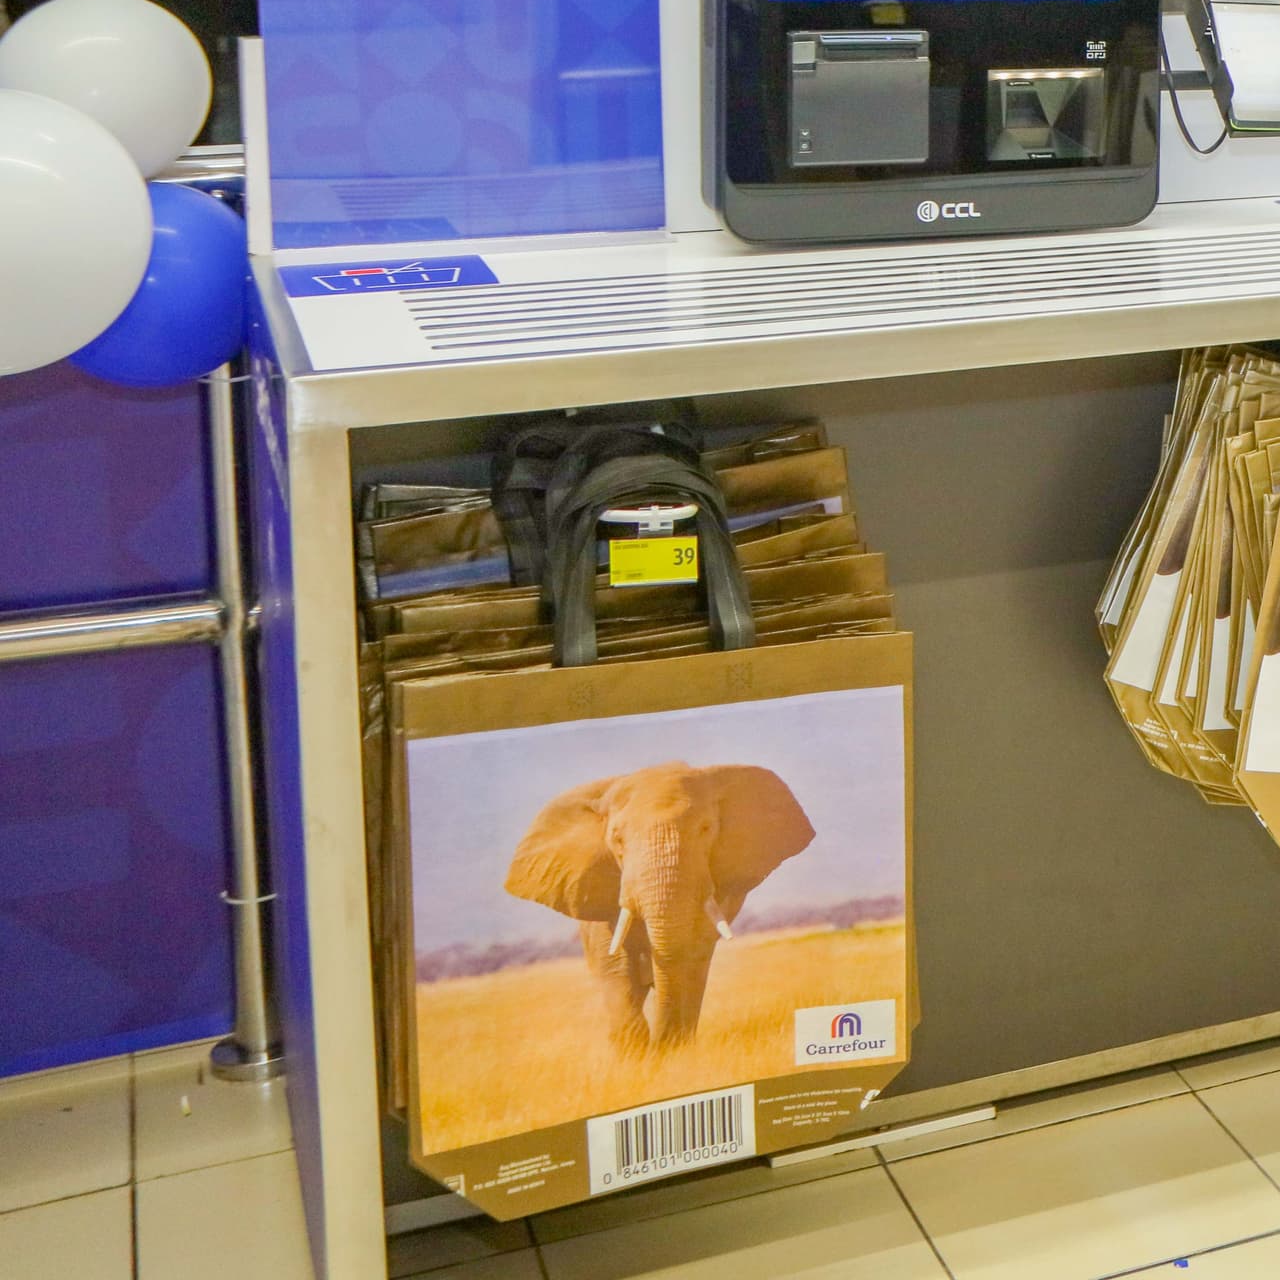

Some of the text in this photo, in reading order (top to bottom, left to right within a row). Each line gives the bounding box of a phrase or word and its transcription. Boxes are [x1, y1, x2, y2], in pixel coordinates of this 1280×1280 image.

[941, 202, 981, 218] CCL
[673, 548, 694, 565] 39
[805, 1037, 886, 1055] Carrefour
[603, 1143, 738, 1185] 0 846101 000040
